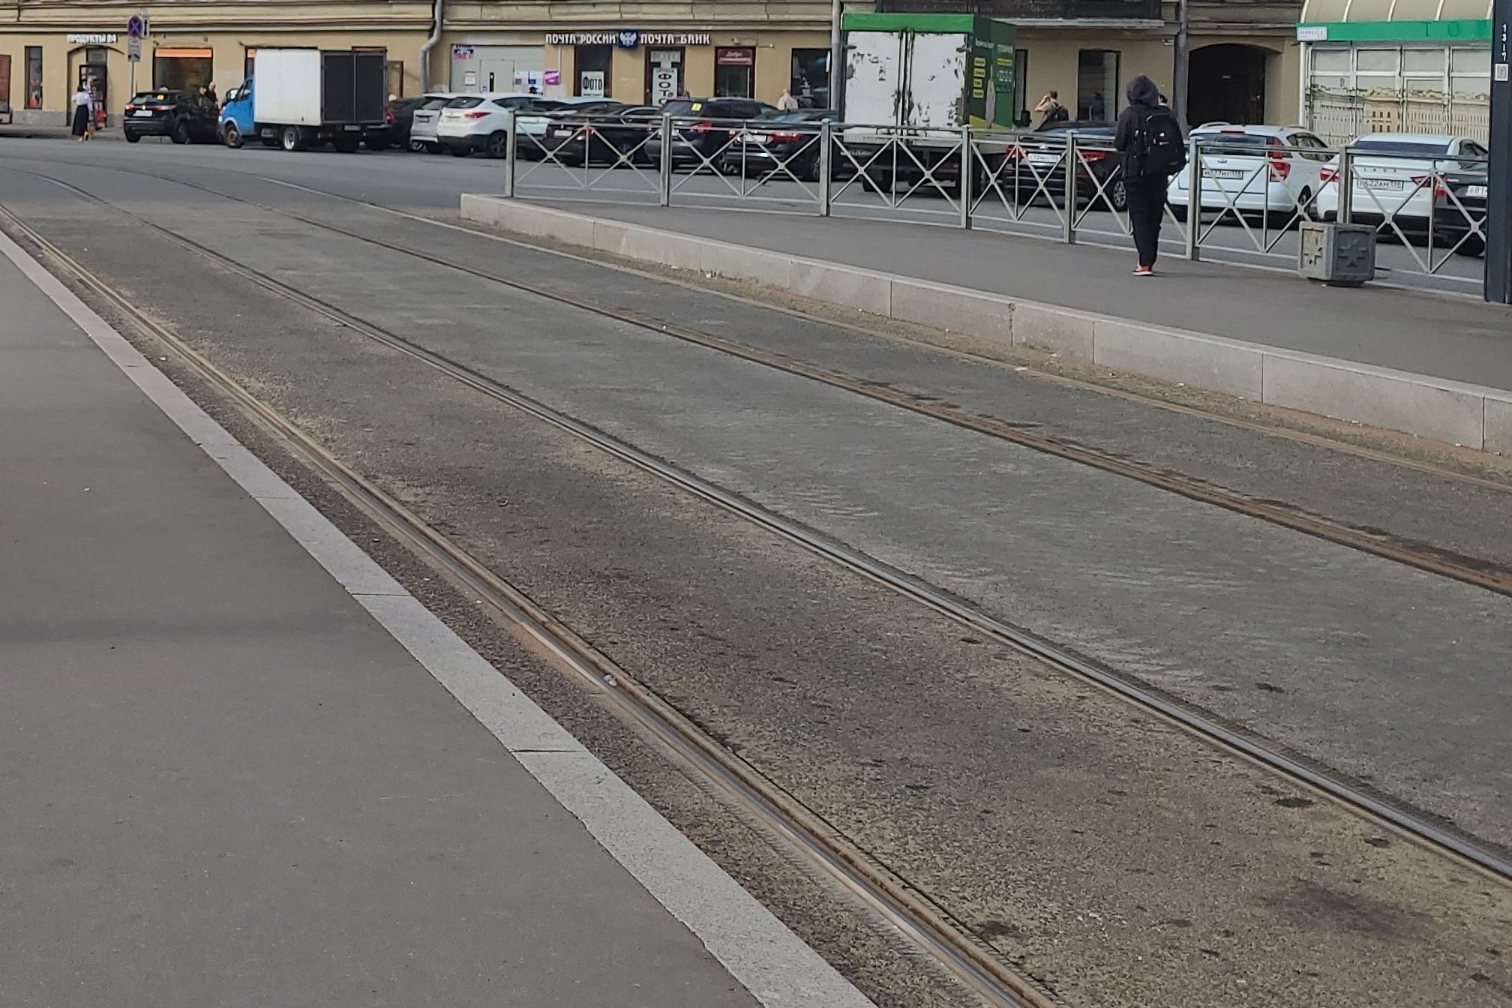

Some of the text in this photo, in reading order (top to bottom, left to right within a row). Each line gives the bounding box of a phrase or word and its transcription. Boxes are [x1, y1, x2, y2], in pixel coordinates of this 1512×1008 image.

[545, 33, 618, 45] ПОЧТА РОССИИ
[640, 33, 710, 45] ПОЧТА БАНК
[583, 76, 603, 91] ФОТО
